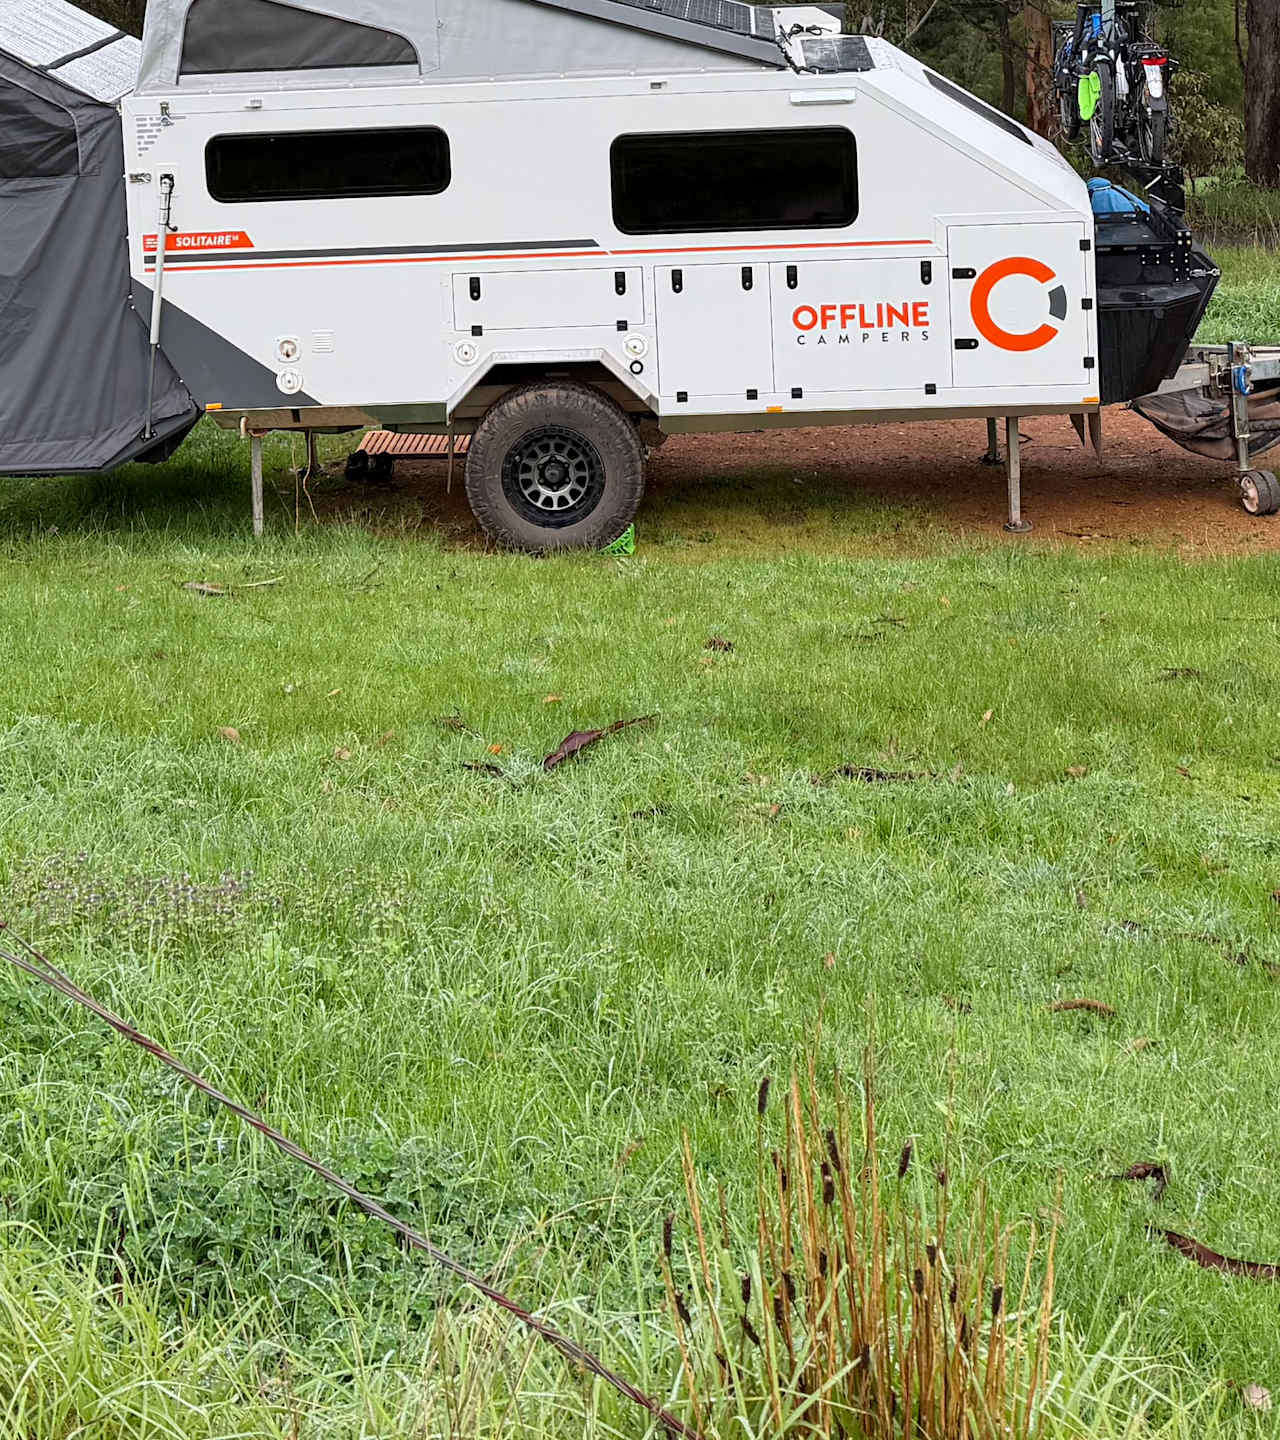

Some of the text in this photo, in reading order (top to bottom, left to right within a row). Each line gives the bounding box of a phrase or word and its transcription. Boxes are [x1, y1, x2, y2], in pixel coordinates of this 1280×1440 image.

[176, 235, 232, 247] SOLITAIRE
[792, 302, 929, 331] OFFLINE
[797, 331, 929, 345] CAMPERS
